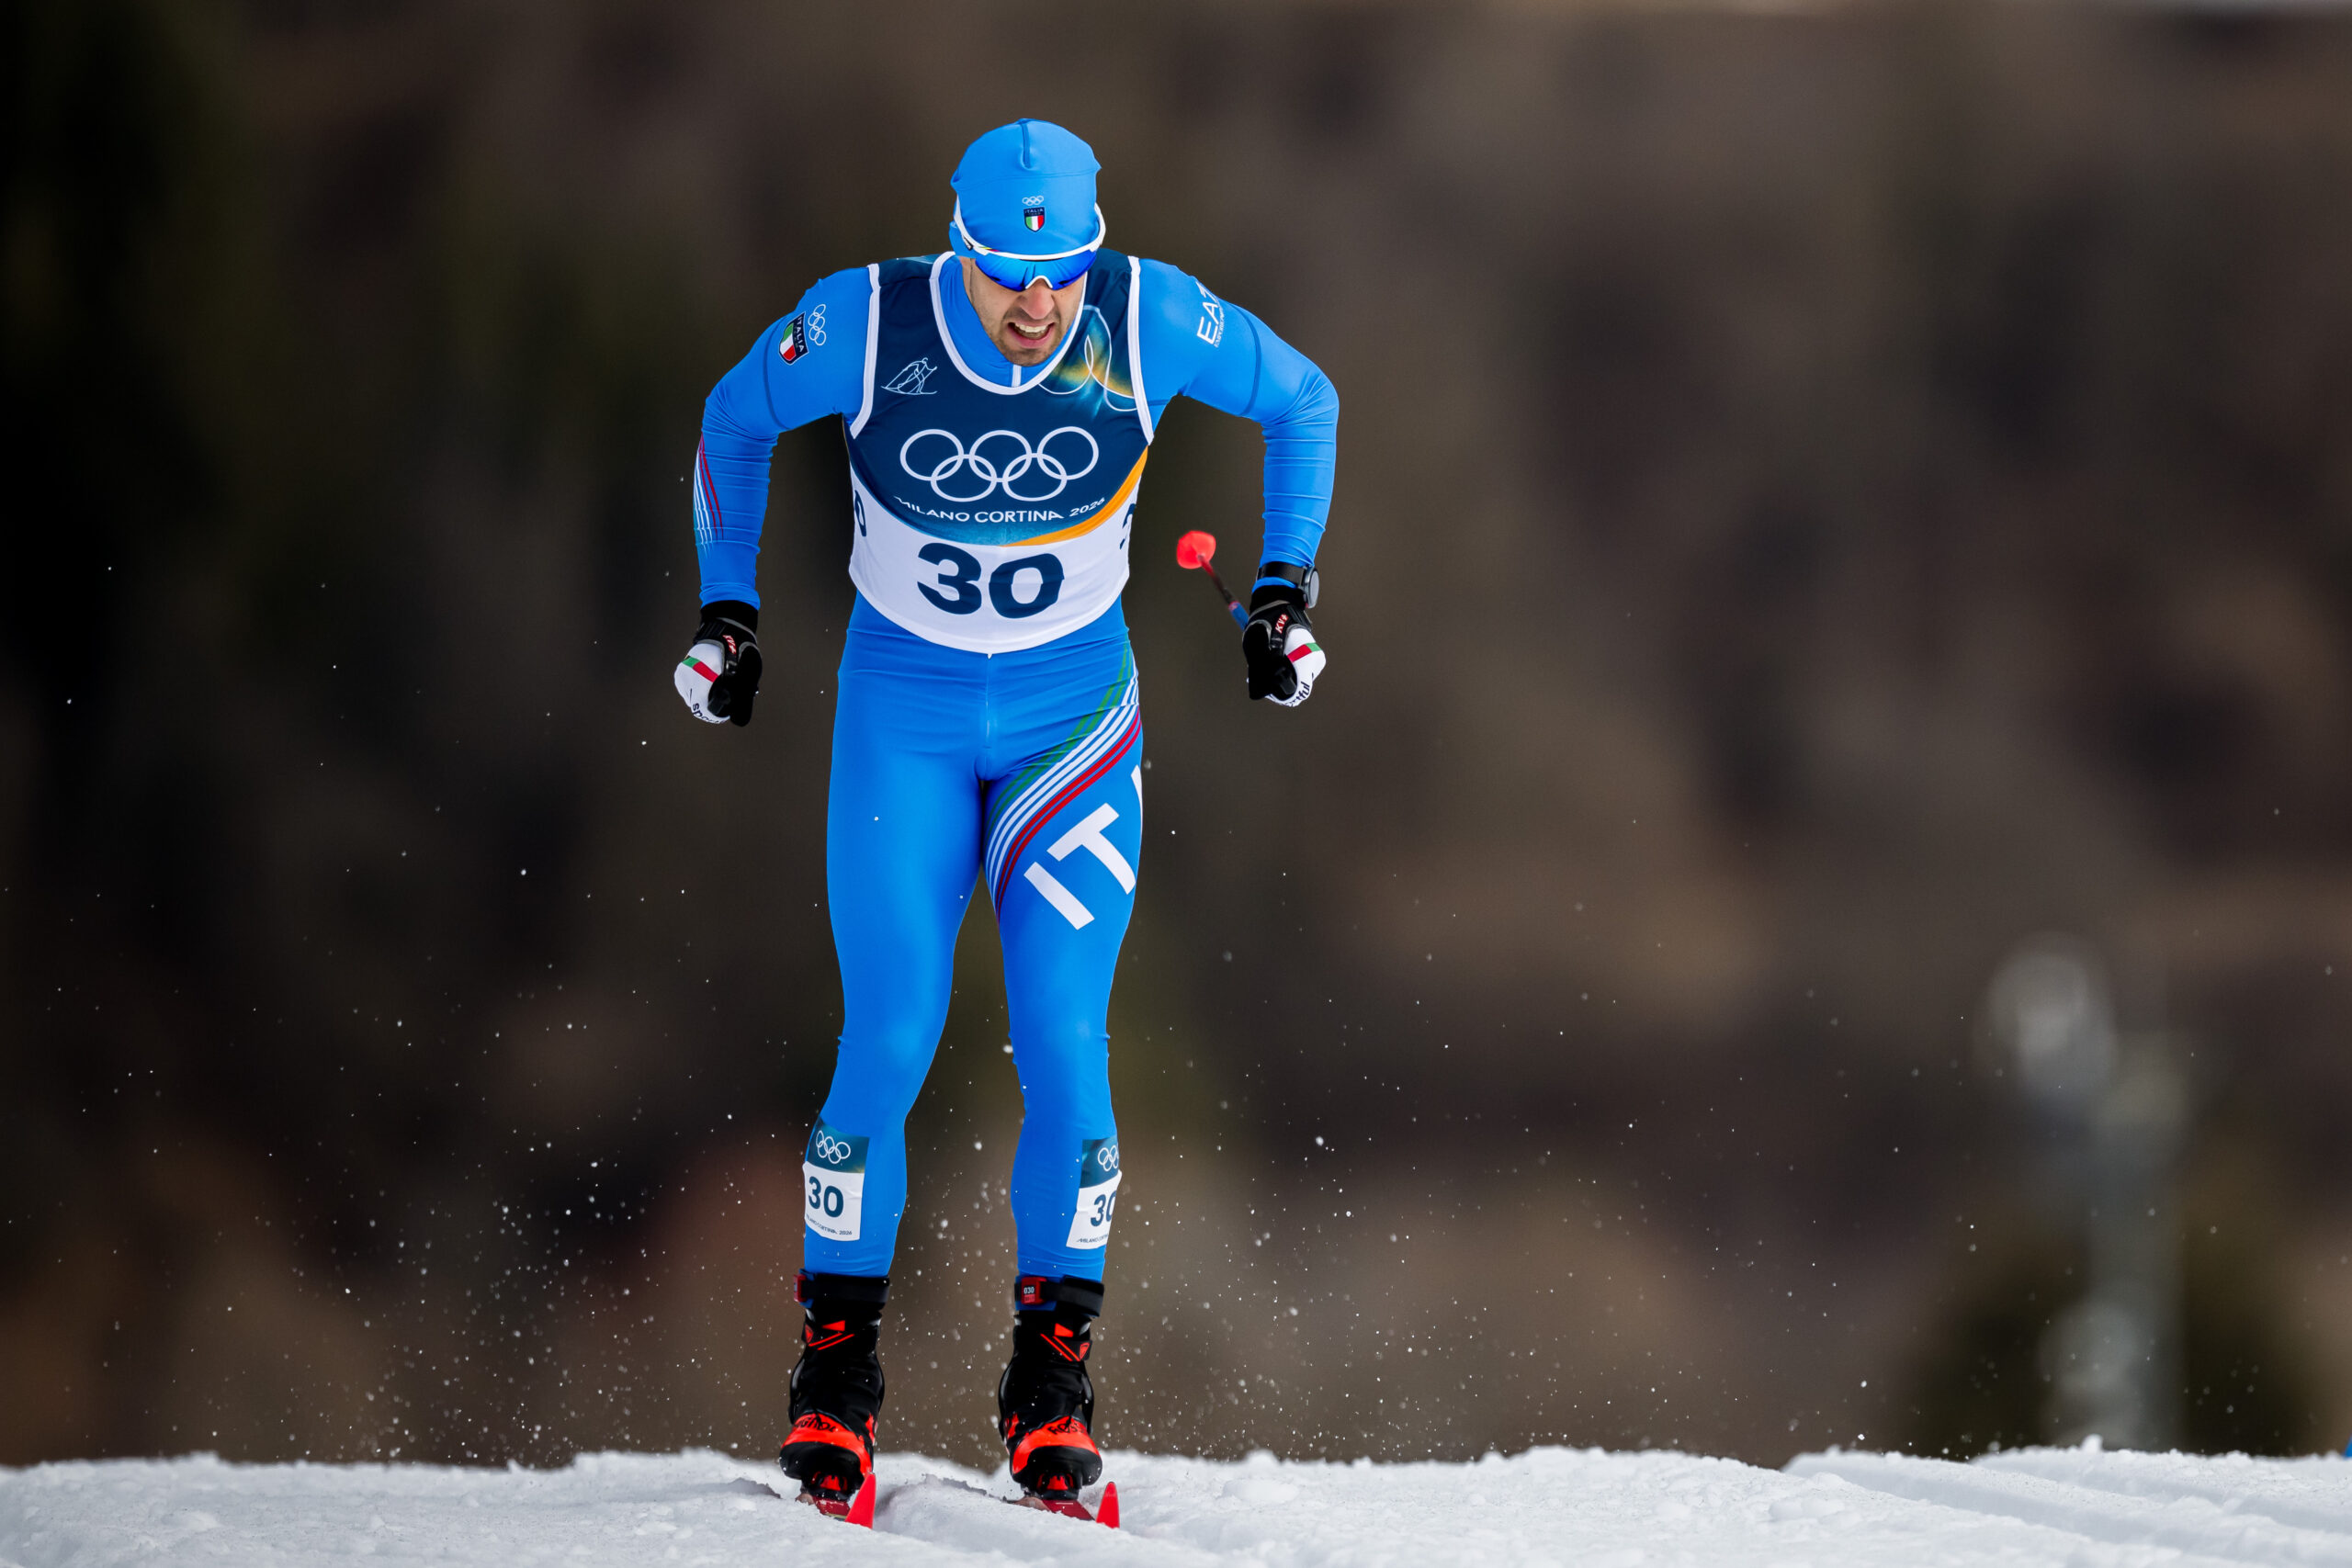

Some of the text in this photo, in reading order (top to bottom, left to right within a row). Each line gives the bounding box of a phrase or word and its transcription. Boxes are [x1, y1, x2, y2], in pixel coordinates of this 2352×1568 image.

[893, 495, 1105, 524] MILANO CORTINA 2026
[917, 542, 1065, 619] 30
[1023, 764, 1143, 931] IT
[808, 1176, 844, 1218] 30
